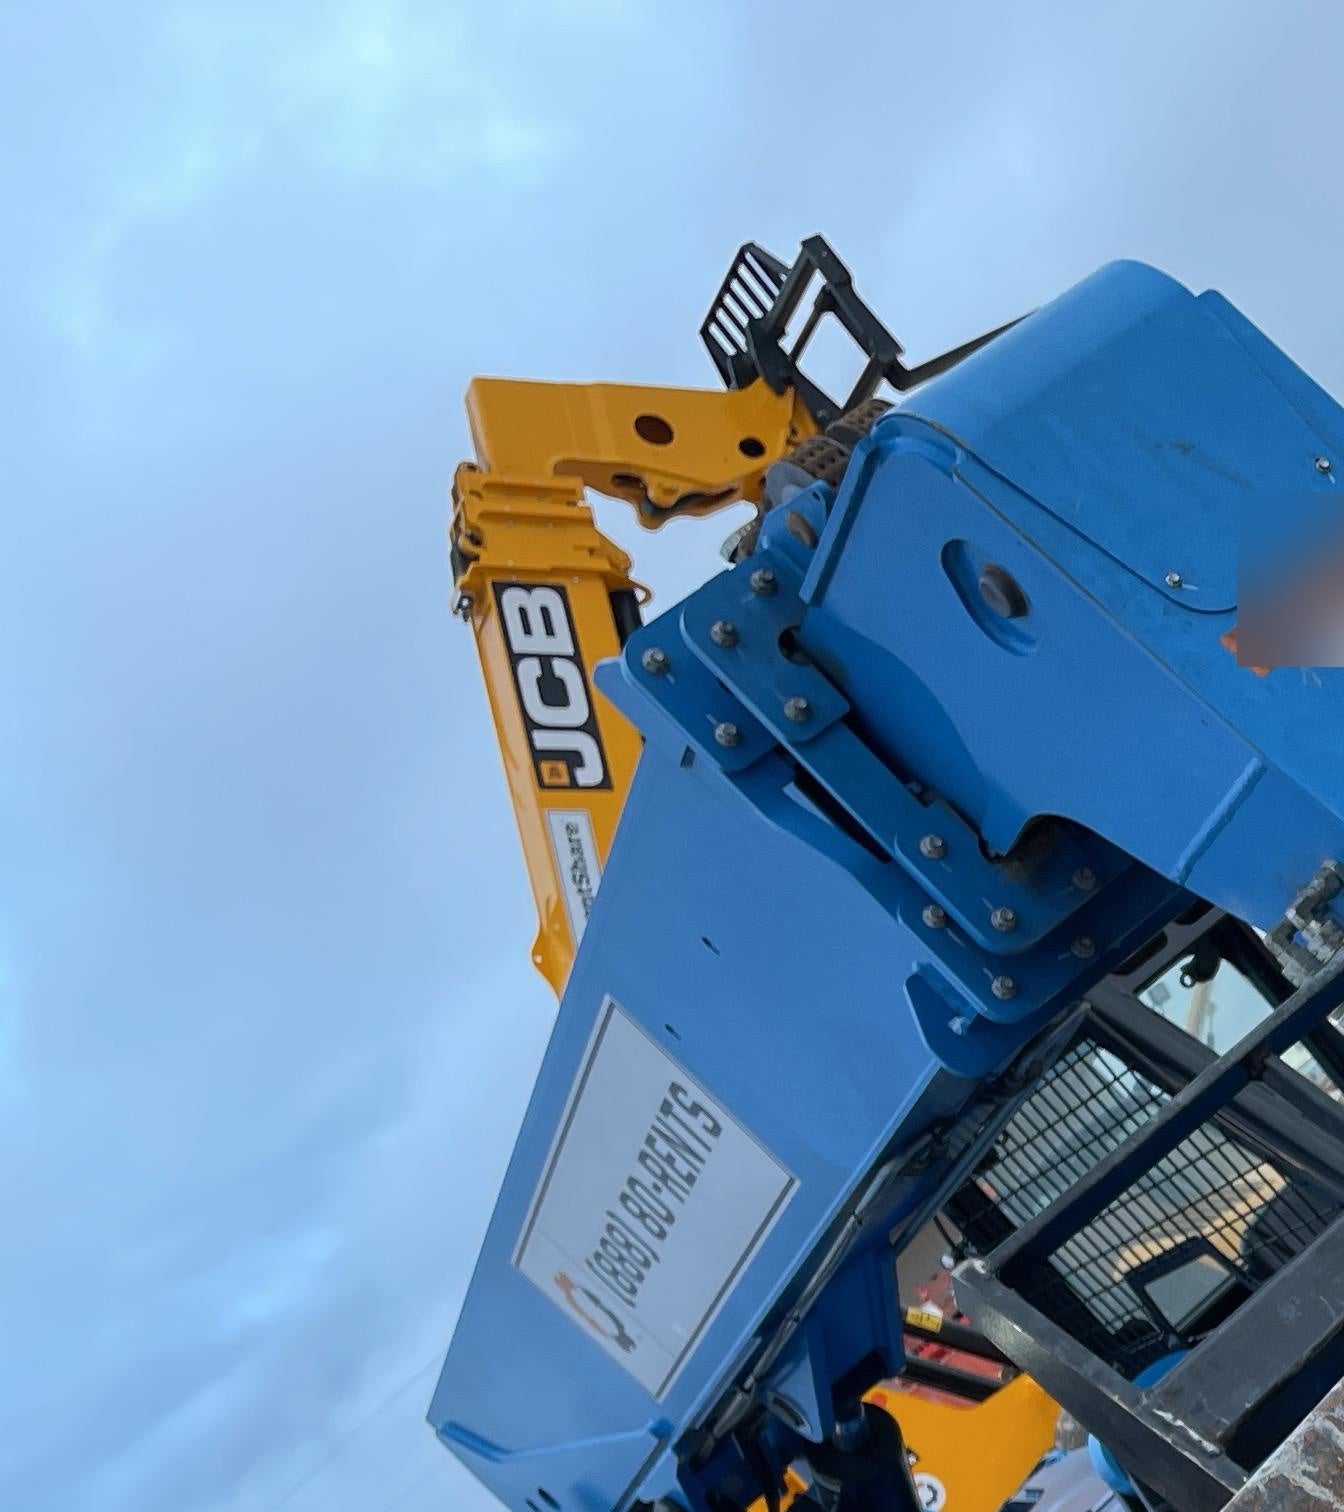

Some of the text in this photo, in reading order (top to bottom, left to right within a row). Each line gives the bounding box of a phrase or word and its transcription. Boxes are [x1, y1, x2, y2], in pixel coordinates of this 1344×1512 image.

[501, 586, 604, 788] JCB
[585, 1080, 723, 1309] (888) 80-RENTS
